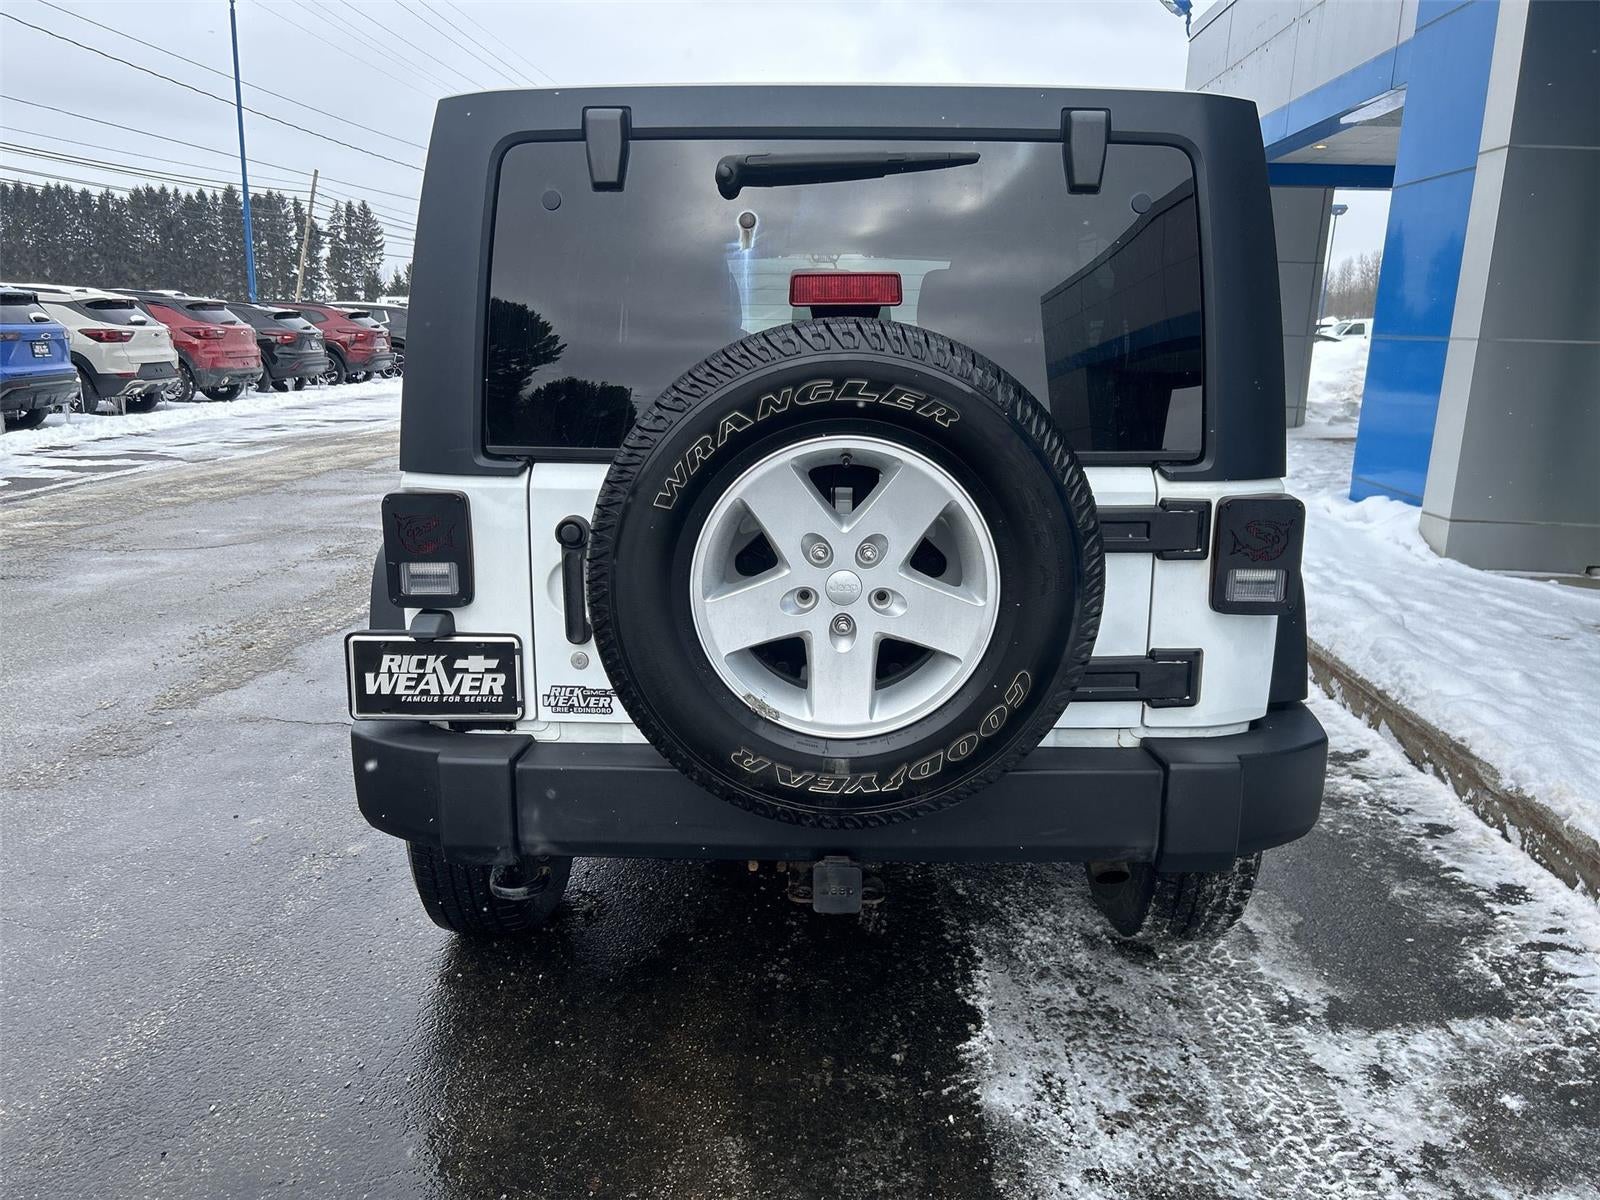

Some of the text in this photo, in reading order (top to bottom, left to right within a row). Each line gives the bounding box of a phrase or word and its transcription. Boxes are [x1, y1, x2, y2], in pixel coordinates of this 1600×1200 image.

[653, 379, 961, 510] WRANGLER
[379, 654, 447, 673] RICK
[364, 672, 506, 695] WEAVER
[550, 687, 583, 696] RICK
[401, 695, 503, 703] FAMOUS FOR SERVICE
[543, 696, 611, 707] WEAVER
[730, 670, 1031, 794] GOODYEAR
